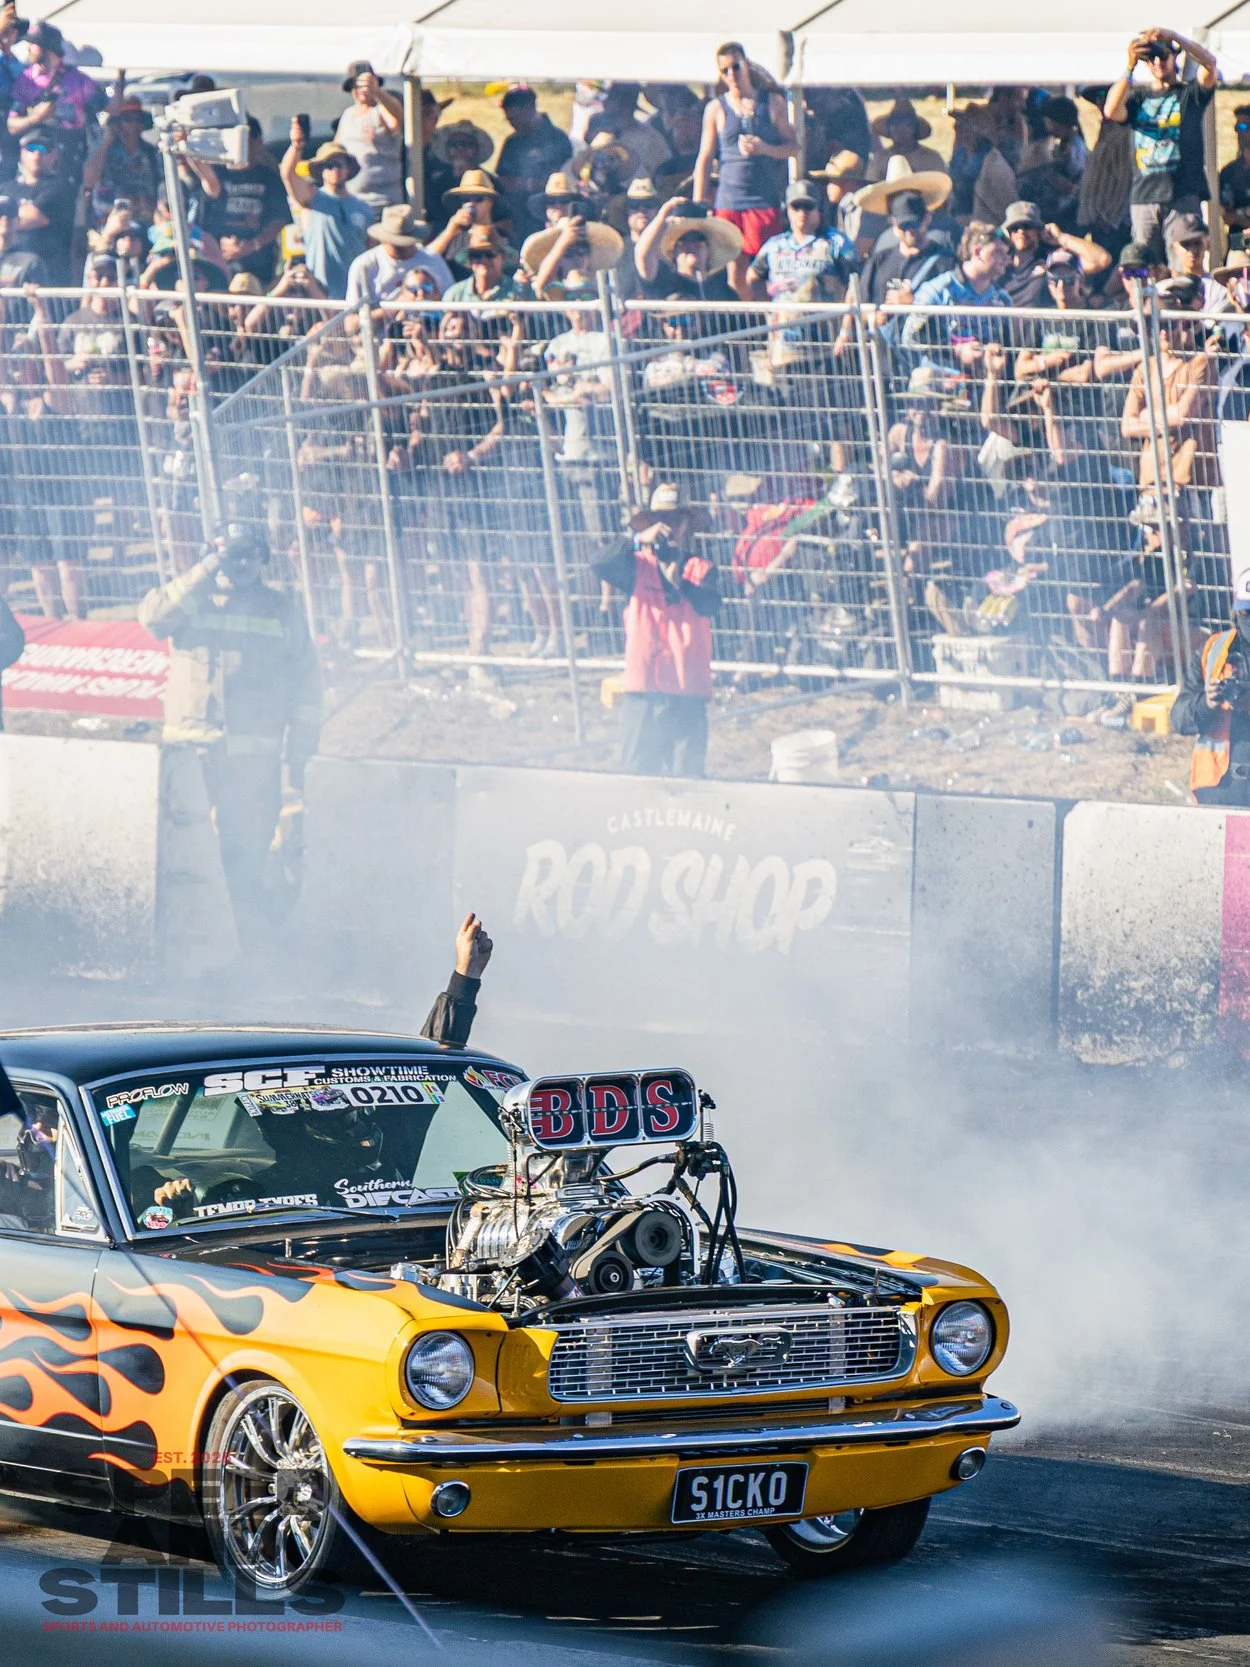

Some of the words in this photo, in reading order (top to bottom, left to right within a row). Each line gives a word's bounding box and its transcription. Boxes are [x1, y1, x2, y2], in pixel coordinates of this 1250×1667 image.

[606, 806, 737, 843] CASTLEMAINE
[512, 838, 652, 943] ROD
[648, 848, 838, 957] SHOP
[203, 1065, 326, 1097] SCF
[314, 1075, 372, 1085] CUSTOMS
[374, 1075, 381, 1083] &
[383, 1074, 457, 1083] FABRICATION
[331, 1065, 429, 1078] SHOWTIME
[106, 1083, 190, 1109] PROFLOW
[350, 1084, 425, 1105] 0210
[530, 1080, 680, 1139] BDS
[333, 1178, 414, 1195] Southern
[695, 1512, 706, 1520] 3X
[707, 1509, 746, 1519] MASTERS
[747, 1507, 776, 1517] CHAMP
